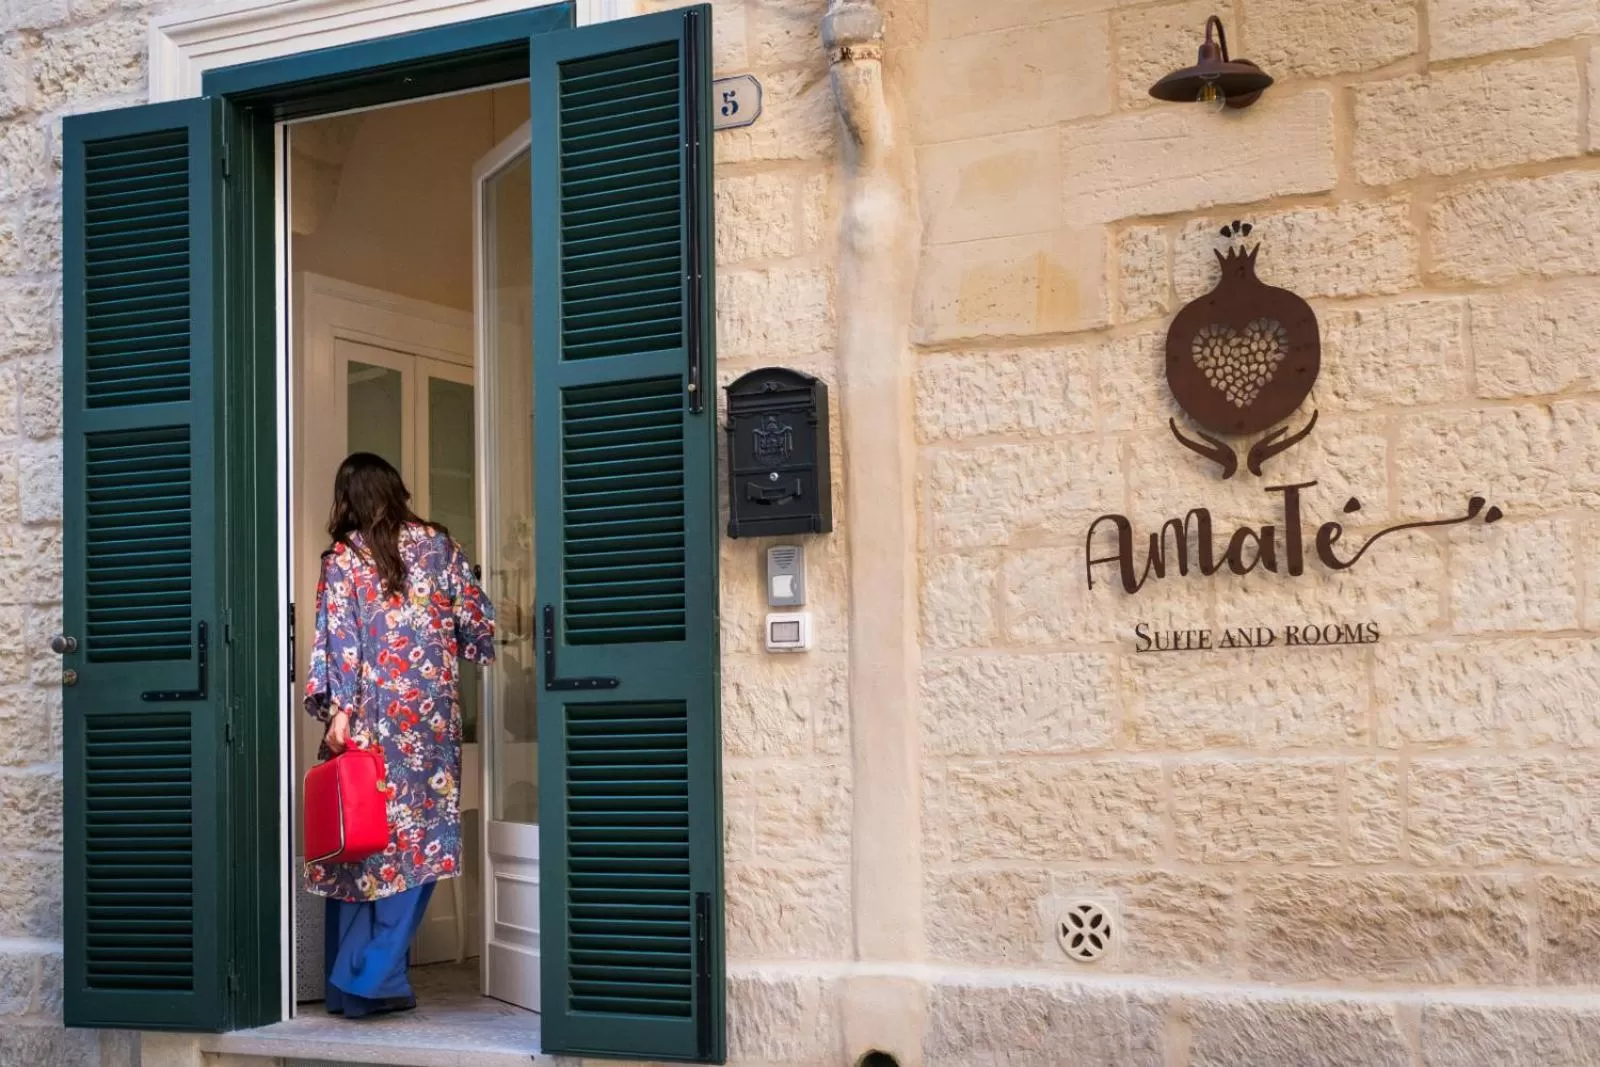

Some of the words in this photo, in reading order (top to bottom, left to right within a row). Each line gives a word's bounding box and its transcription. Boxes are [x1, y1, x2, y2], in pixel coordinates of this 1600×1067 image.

[721, 90, 739, 117] 5
[1218, 626, 1277, 649] AND
[1284, 622, 1380, 646] ROOMS
